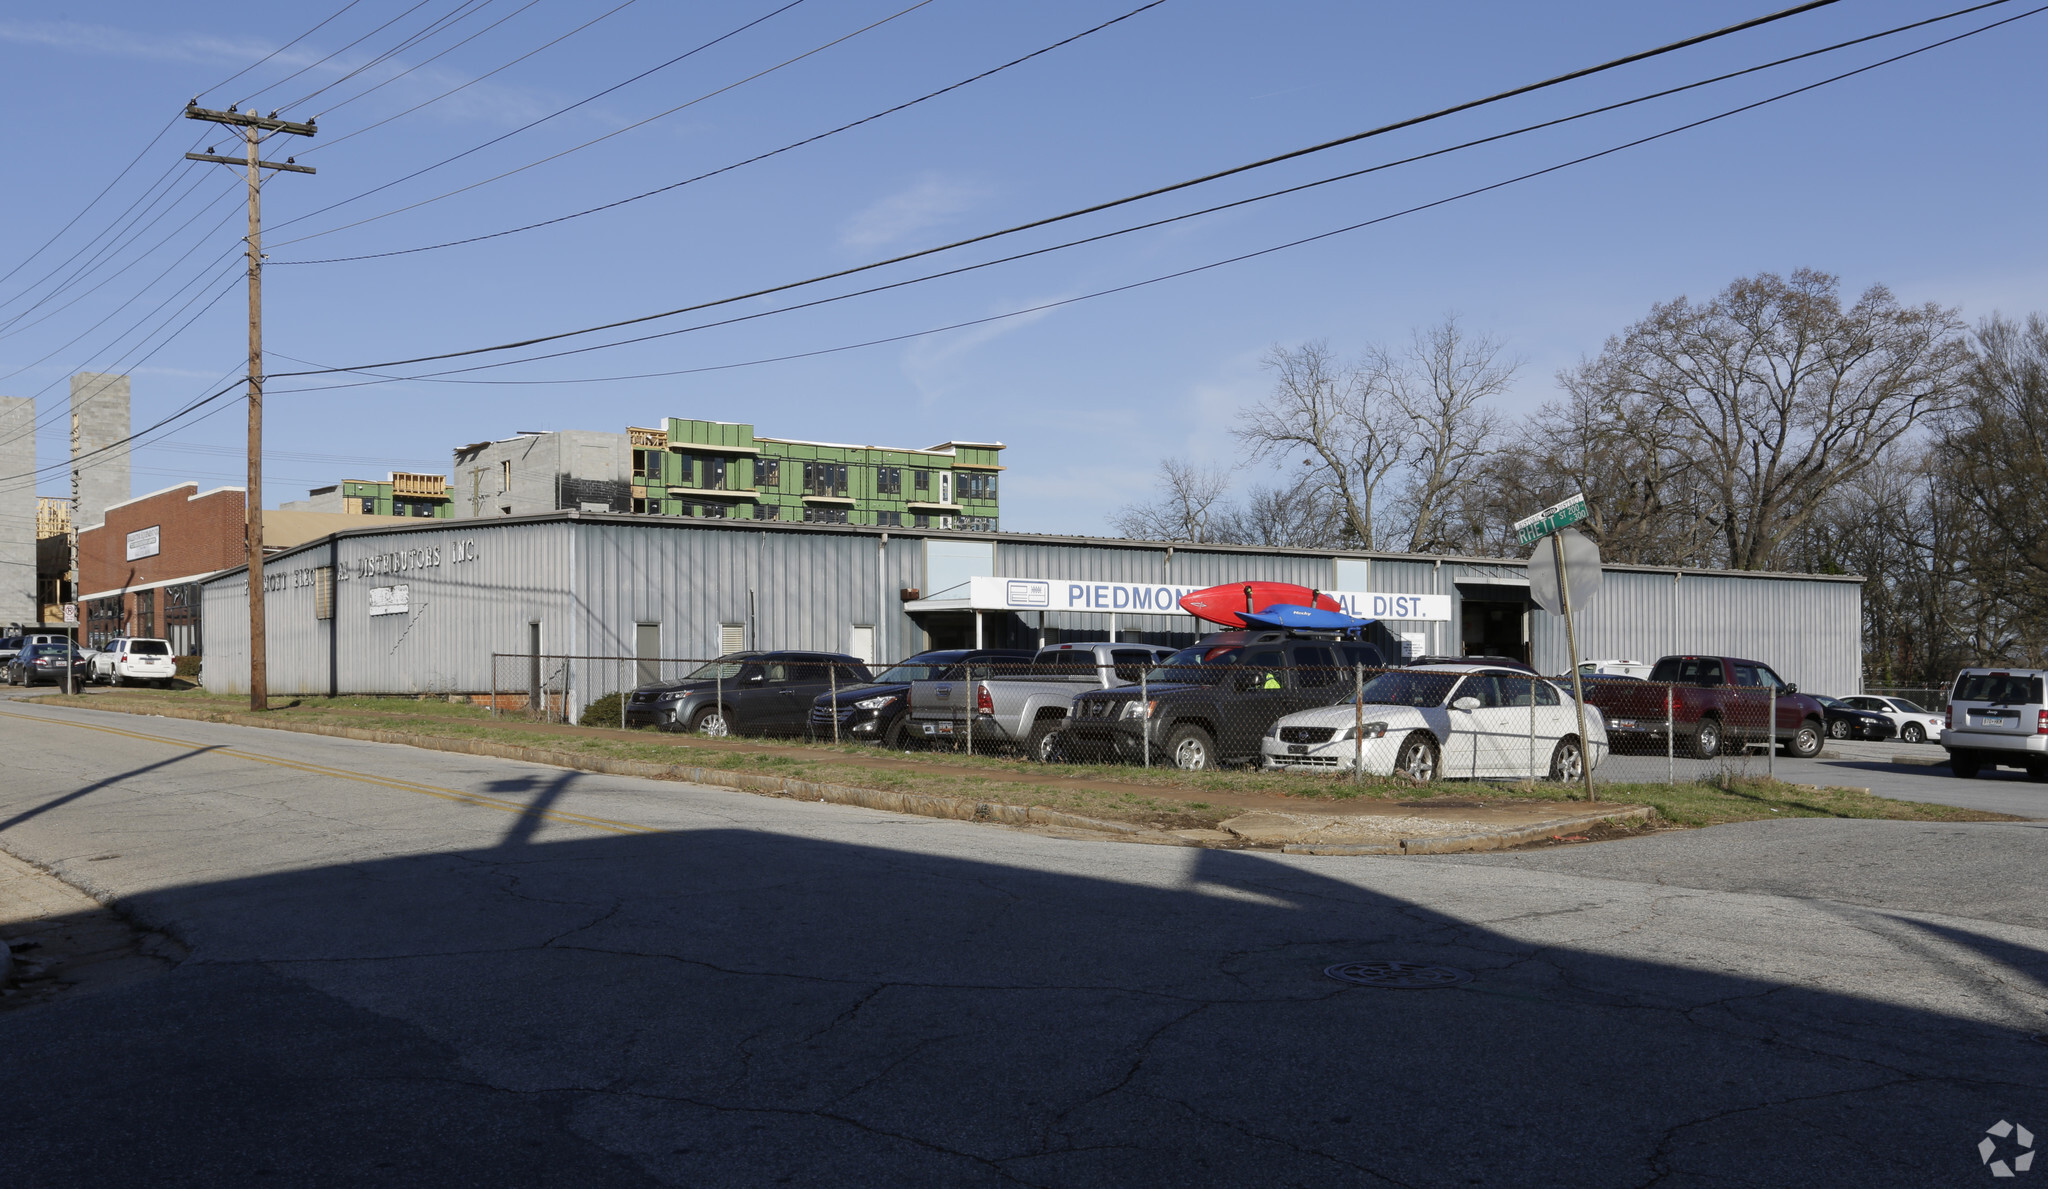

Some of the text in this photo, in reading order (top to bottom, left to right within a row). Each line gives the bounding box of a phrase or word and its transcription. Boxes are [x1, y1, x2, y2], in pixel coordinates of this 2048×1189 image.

[1518, 514, 1556, 544] RHETT
[1559, 510, 1568, 520] ST
[1568, 503, 1580, 516] 200
[1574, 509, 1586, 521] 300
[357, 544, 441, 579] DISTRIBUTORS
[451, 537, 480, 564] INC.
[1068, 584, 1199, 611] PIEDMON
[1374, 596, 1427, 617] DIST.
